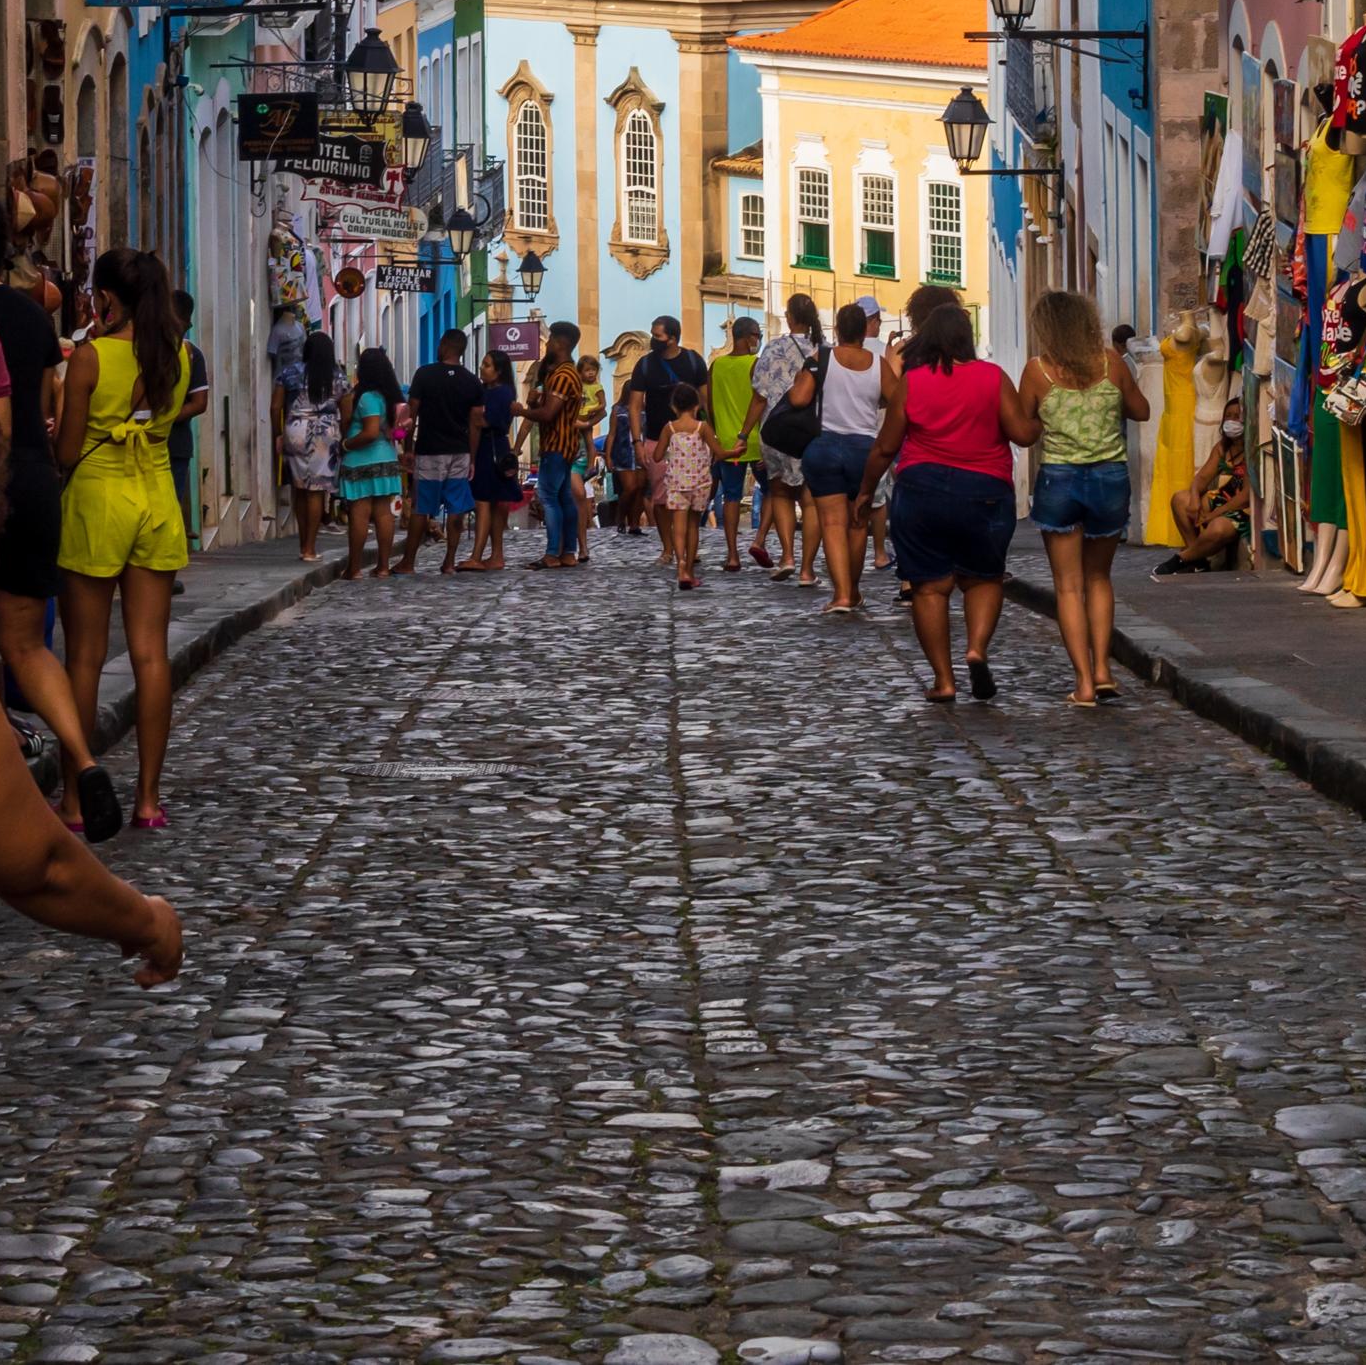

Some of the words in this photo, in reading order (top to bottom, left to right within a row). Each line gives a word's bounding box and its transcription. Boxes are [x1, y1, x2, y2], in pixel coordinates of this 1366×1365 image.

[319, 143, 350, 160] TEL
[342, 214, 392, 228] CULTURAL
[394, 221, 425, 232] HOUSE
